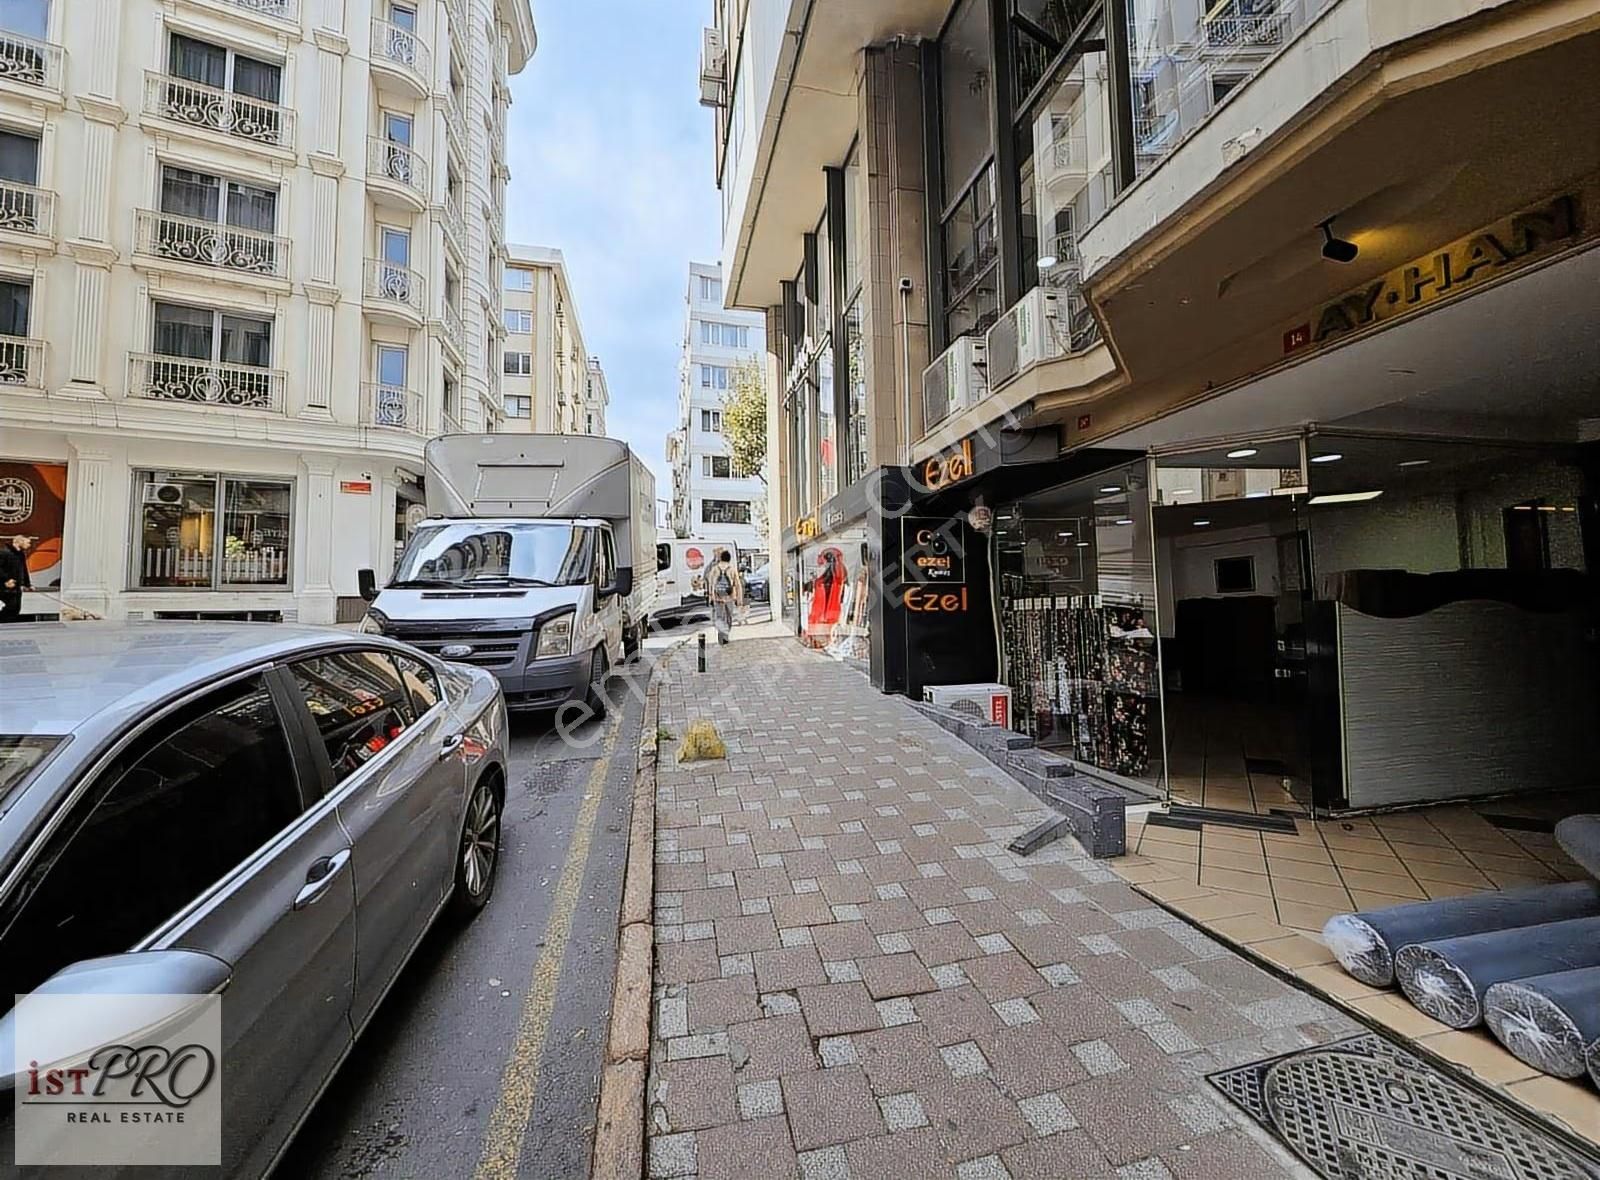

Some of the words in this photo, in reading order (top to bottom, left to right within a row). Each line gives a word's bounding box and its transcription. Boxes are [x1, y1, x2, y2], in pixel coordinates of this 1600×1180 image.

[925, 438, 973, 490] Ezel
[917, 556, 950, 568] ezel
[904, 587, 967, 611] Ezel
